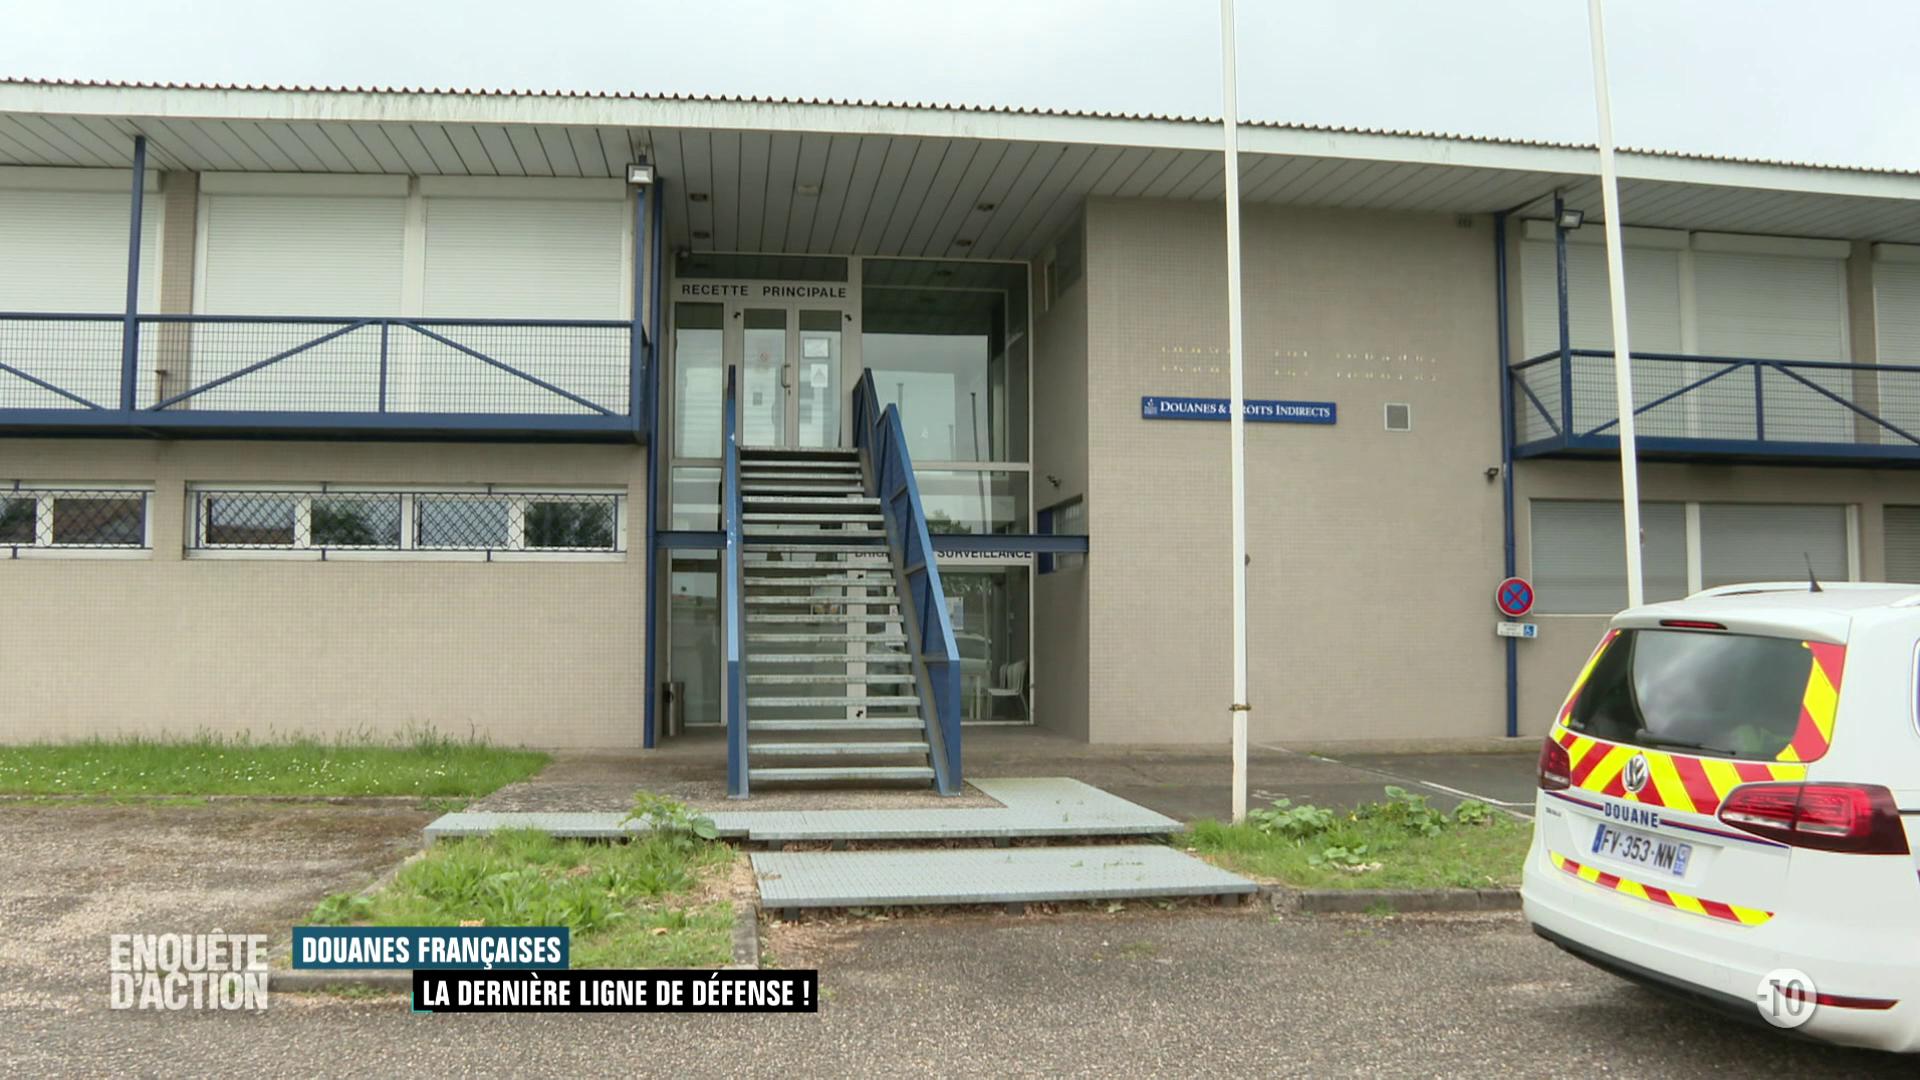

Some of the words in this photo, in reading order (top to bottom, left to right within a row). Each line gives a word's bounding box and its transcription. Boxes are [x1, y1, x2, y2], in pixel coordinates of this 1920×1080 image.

[682, 284, 748, 296] RECETTE
[763, 286, 847, 298] PRINCIPALE
[1160, 401, 1216, 413] DOUANES
[1218, 403, 1226, 414] &
[1229, 403, 1273, 416] ROITS
[1276, 404, 1330, 418] INDIRECTS
[937, 550, 1032, 559] SURVEILLANCE
[1604, 802, 1659, 828] DOUANE
